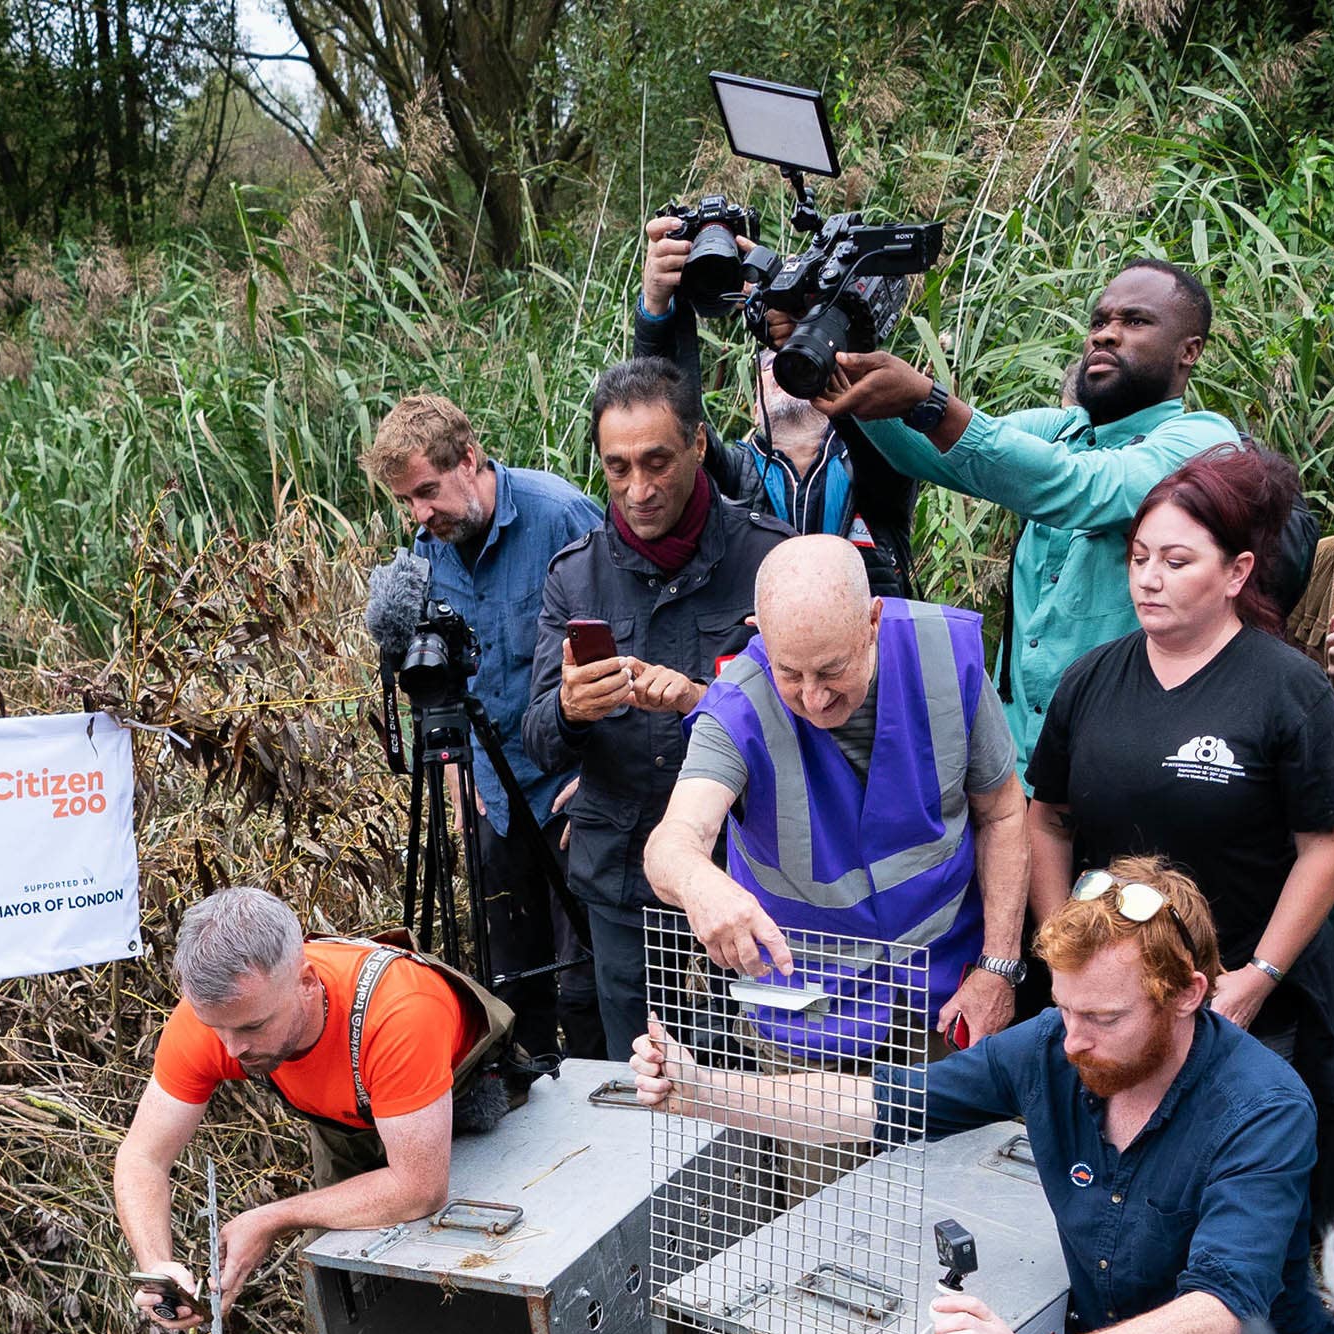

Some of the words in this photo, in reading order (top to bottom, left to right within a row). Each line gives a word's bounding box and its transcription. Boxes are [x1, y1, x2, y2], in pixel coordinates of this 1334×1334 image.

[388, 692, 396, 731] DIGITAL
[391, 733, 399, 754] EOS
[1196, 735, 1218, 763] 8
[52, 793, 107, 819] zoo
[24, 879, 79, 893] SUPPORTED
[44, 898, 65, 912] OF
[68, 888, 124, 910] LONDON
[354, 966, 375, 1009] trakker
[351, 1026, 362, 1068] trakker
